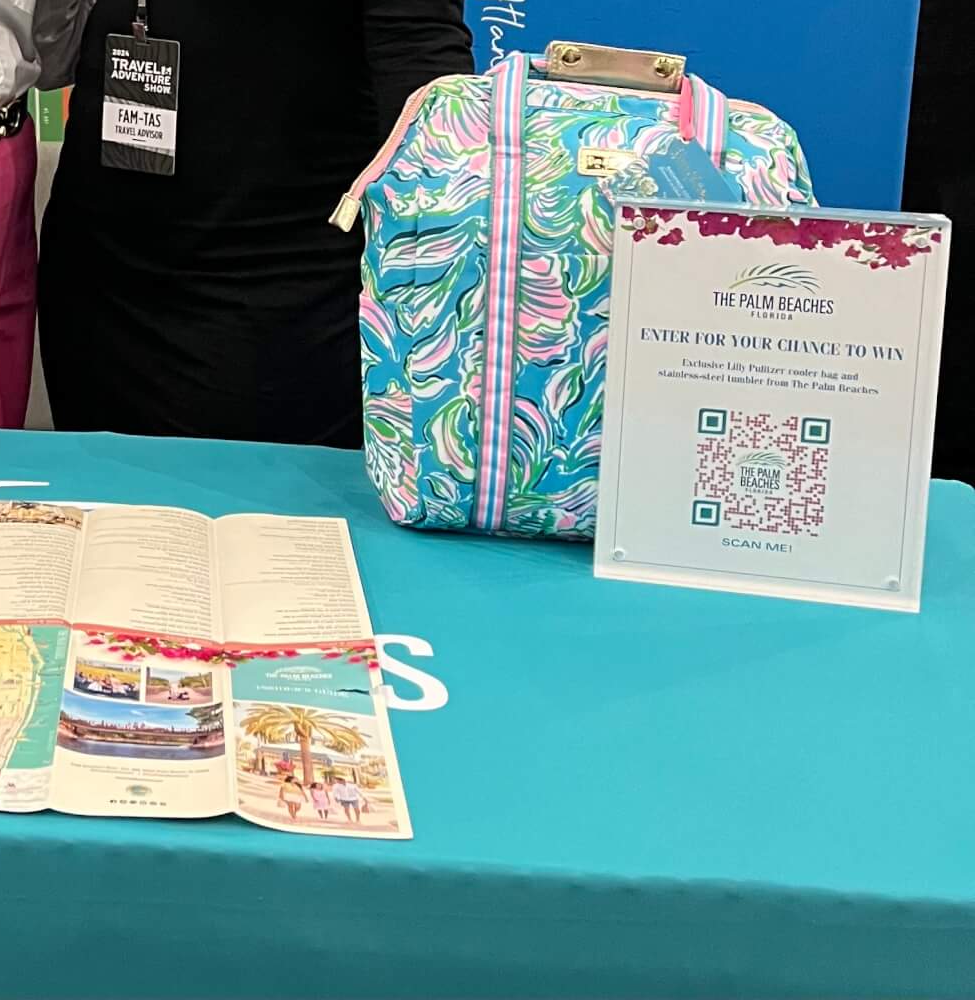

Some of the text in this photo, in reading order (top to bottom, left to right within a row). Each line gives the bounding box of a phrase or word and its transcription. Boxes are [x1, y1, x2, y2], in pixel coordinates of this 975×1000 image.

[111, 58, 161, 76] TRAVEL
[111, 69, 171, 86] ADVENTURE
[144, 83, 171, 94] SHOW
[118, 108, 163, 128] FAM-TAS
[115, 125, 163, 140] TRAVEL ADVISOR
[713, 291, 835, 316] THE PALM BEACHES
[750, 311, 795, 322] FLORIDA
[640, 327, 905, 362] ENTER FOR YOUR CHANCE TO WIN
[681, 358, 725, 370] Exclusive
[727, 361, 747, 374] Lilly
[788, 367, 819, 378] cooler
[820, 370, 839, 380] bag
[841, 371, 859, 382] and
[658, 369, 879, 396] stainless-steel tumbler from The Palm Beaches
[740, 466, 781, 480] THE PALM
[740, 477, 781, 490] BEACHES
[722, 537, 793, 554] SCAN ME!
